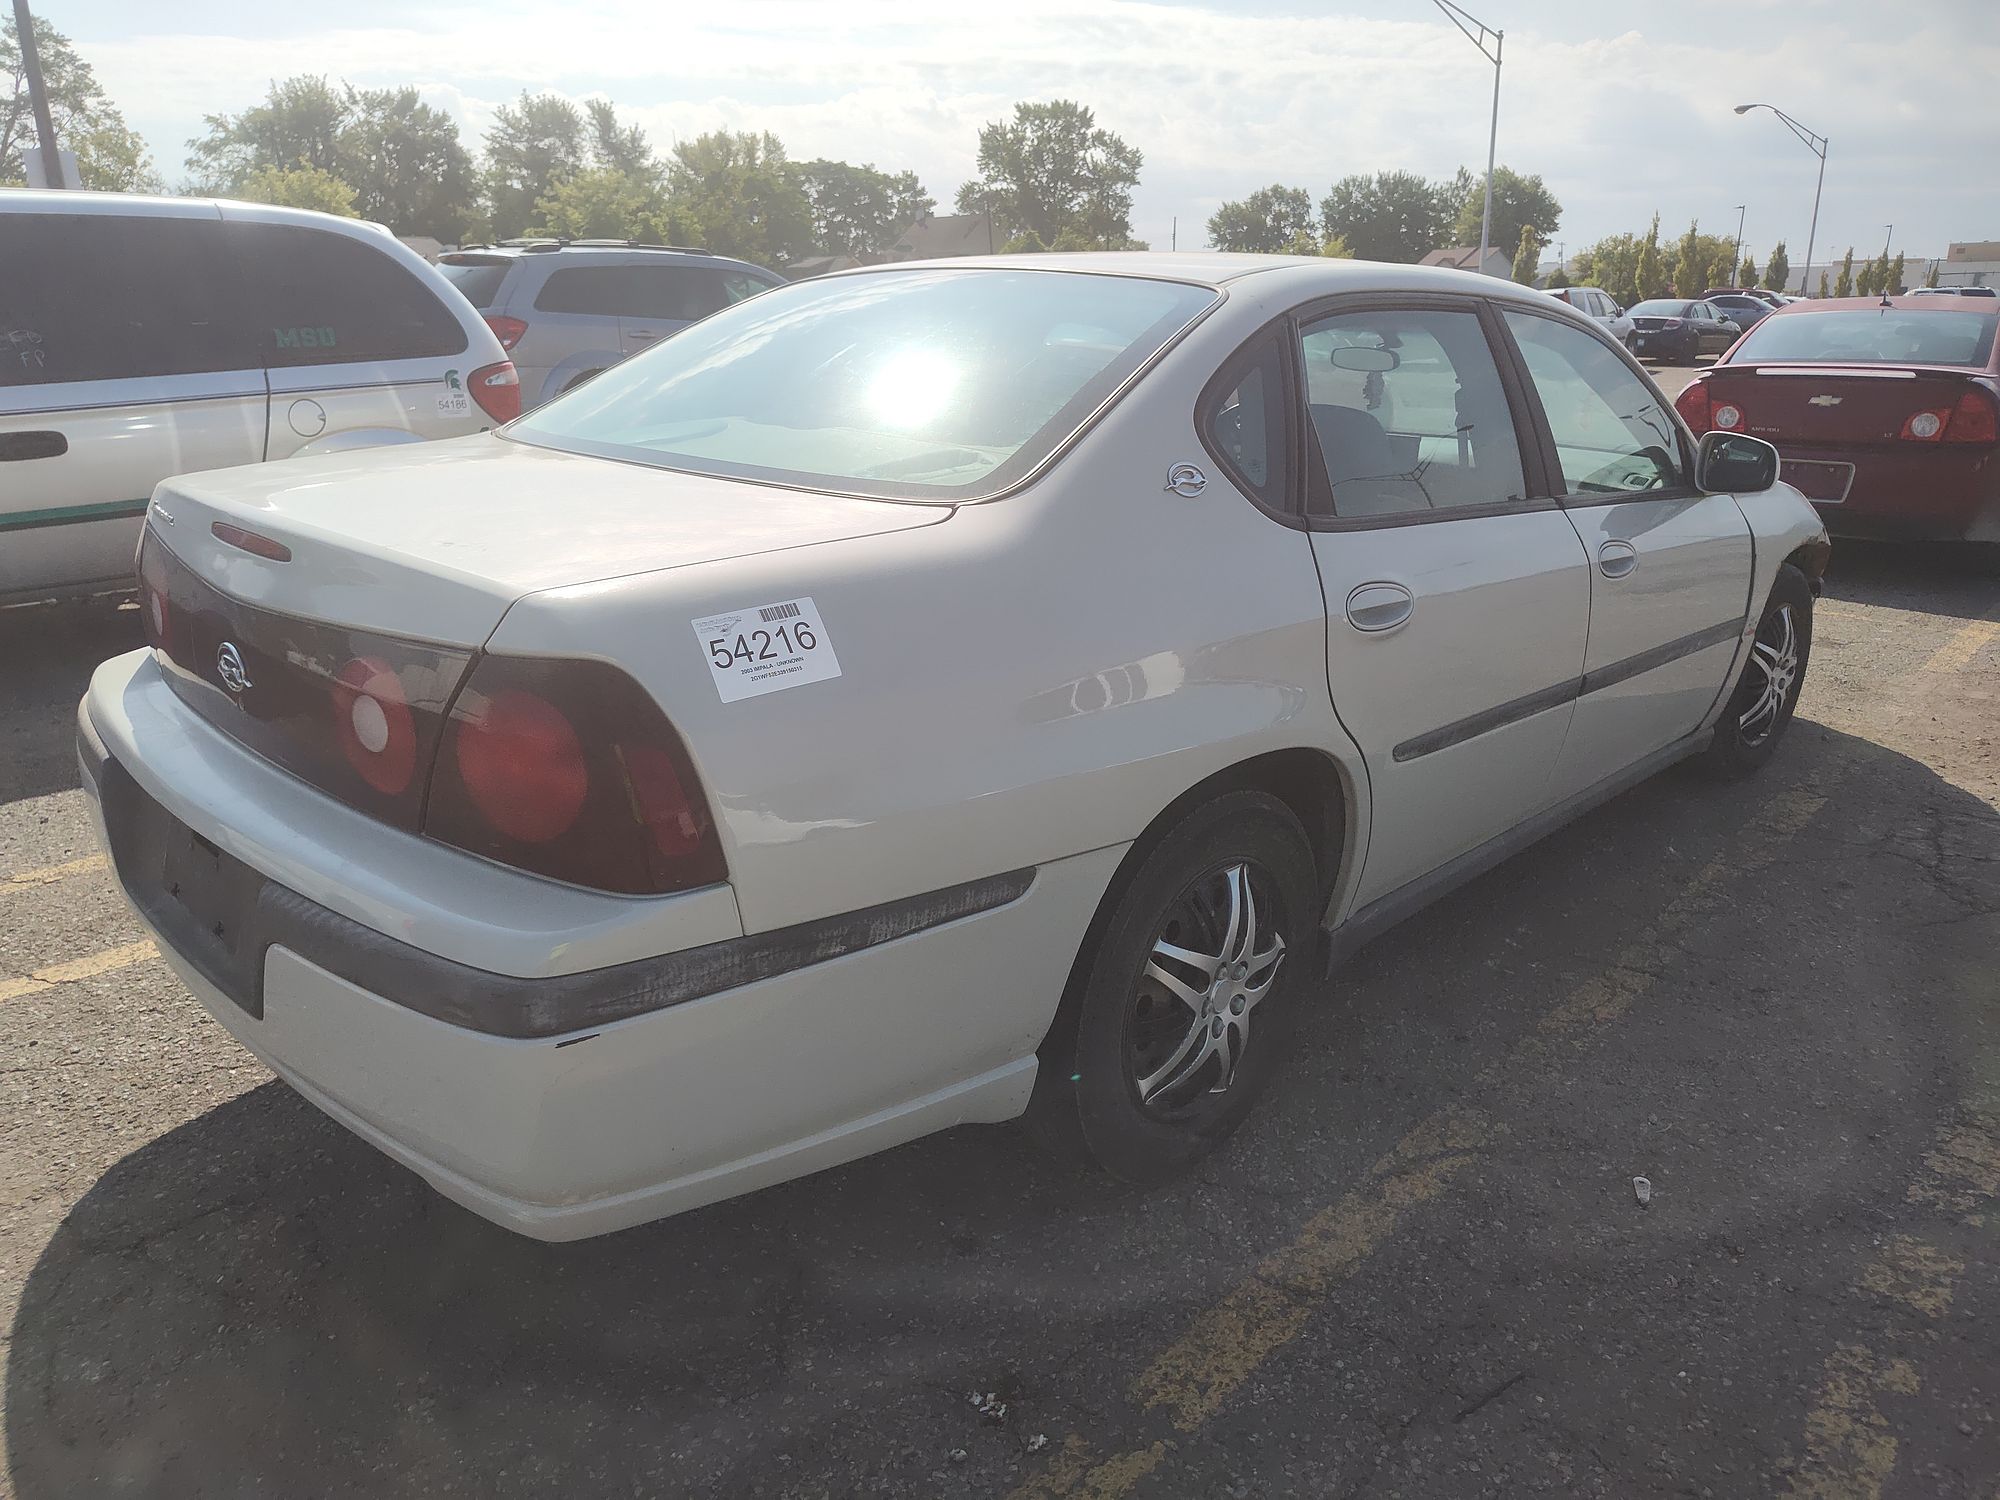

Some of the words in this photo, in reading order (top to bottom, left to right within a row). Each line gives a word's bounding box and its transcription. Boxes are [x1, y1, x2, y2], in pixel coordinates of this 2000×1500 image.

[273, 327, 336, 348] MSU
[709, 622, 817, 669] 54216
[740, 667, 753, 675] 2003
[753, 663, 774, 672] IMPALA
[776, 656, 804, 667] UNKNOWN
